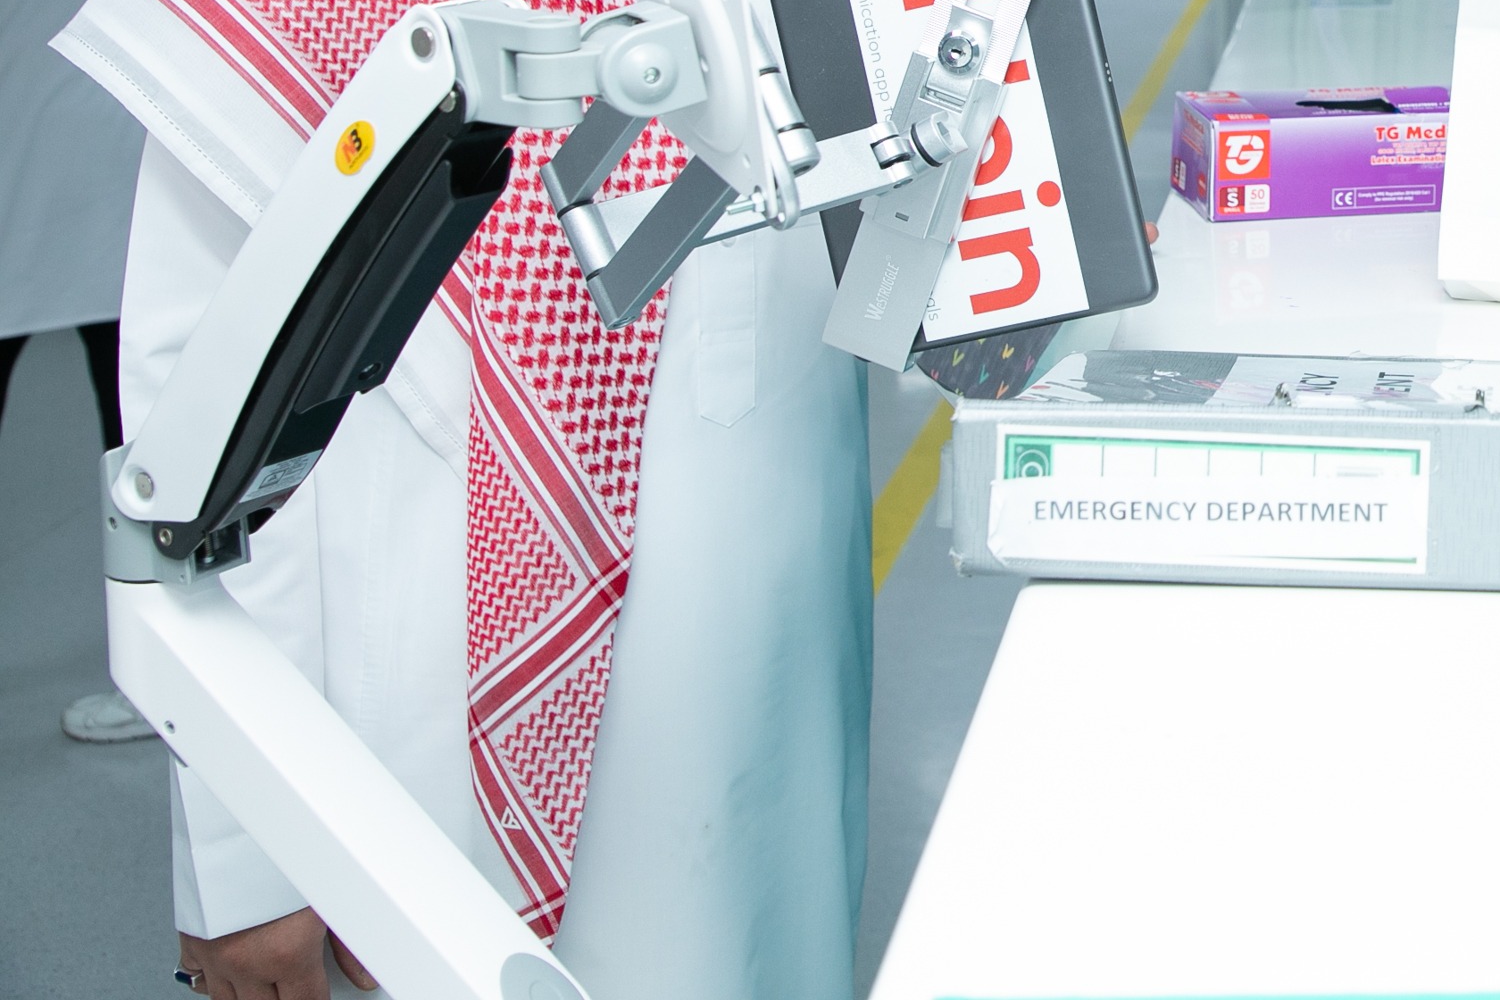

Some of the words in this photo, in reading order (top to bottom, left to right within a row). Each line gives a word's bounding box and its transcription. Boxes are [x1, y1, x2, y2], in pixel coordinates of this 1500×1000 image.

[872, 67, 891, 102] app
[1376, 126, 1399, 140] TG
[1225, 135, 1264, 175] TG
[1227, 193, 1239, 207] S
[1250, 189, 1265, 200] 50
[1295, 373, 1339, 396] NCY
[1034, 500, 1198, 521] EMERGENCY
[1206, 501, 1389, 523] DEPARTMENT
